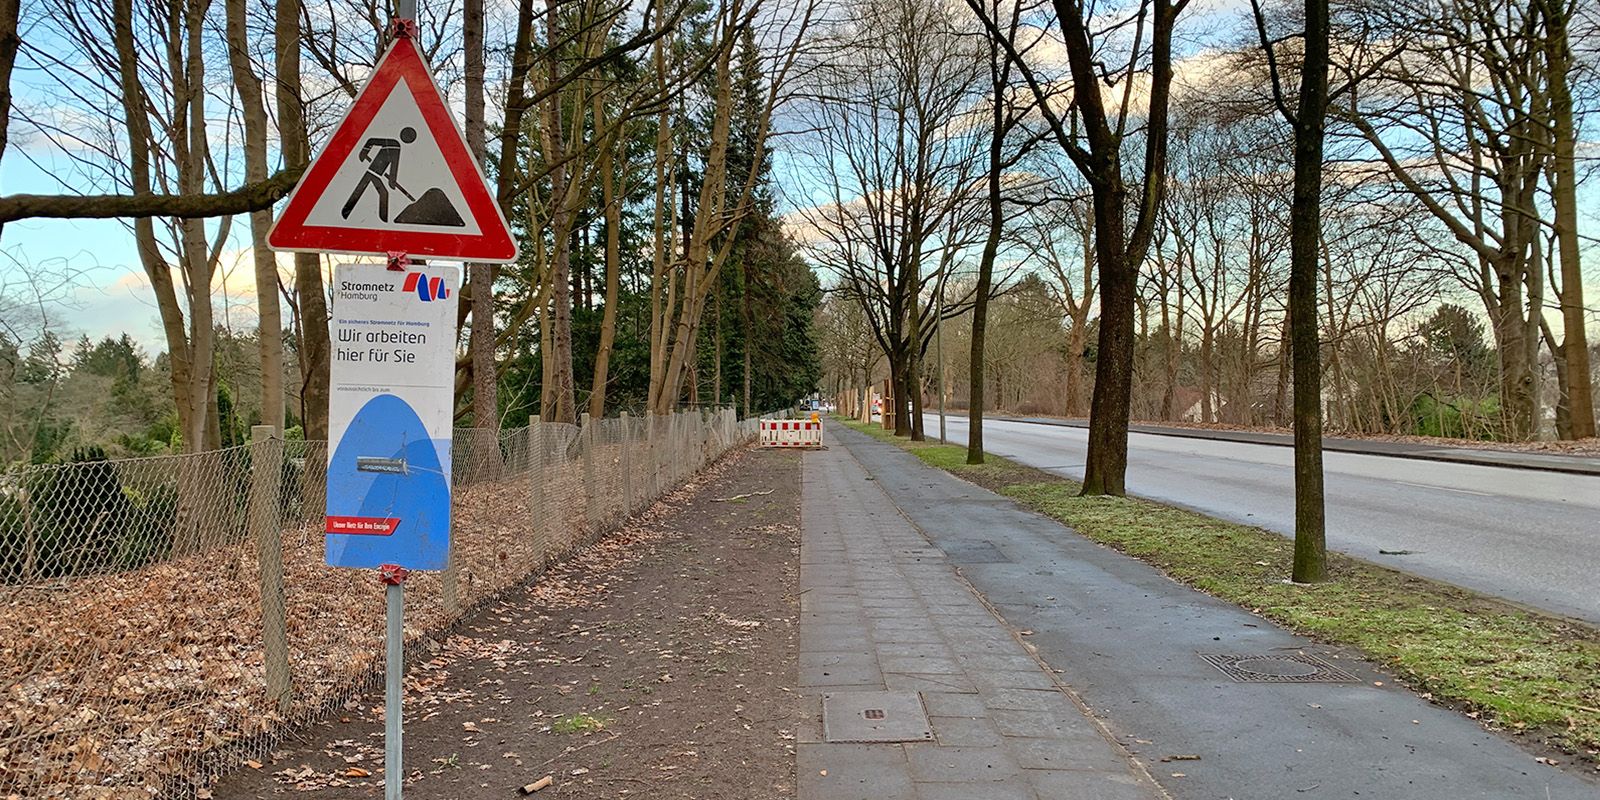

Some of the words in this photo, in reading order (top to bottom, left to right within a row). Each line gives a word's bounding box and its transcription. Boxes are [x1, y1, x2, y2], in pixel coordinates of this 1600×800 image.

[341, 281, 394, 291] Stromnetz
[341, 292, 378, 302] Hamburg
[338, 328, 362, 342] Wir
[366, 330, 426, 344] arbeiten
[337, 348, 364, 362] hier
[368, 348, 389, 362] für
[393, 349, 416, 363] Sie
